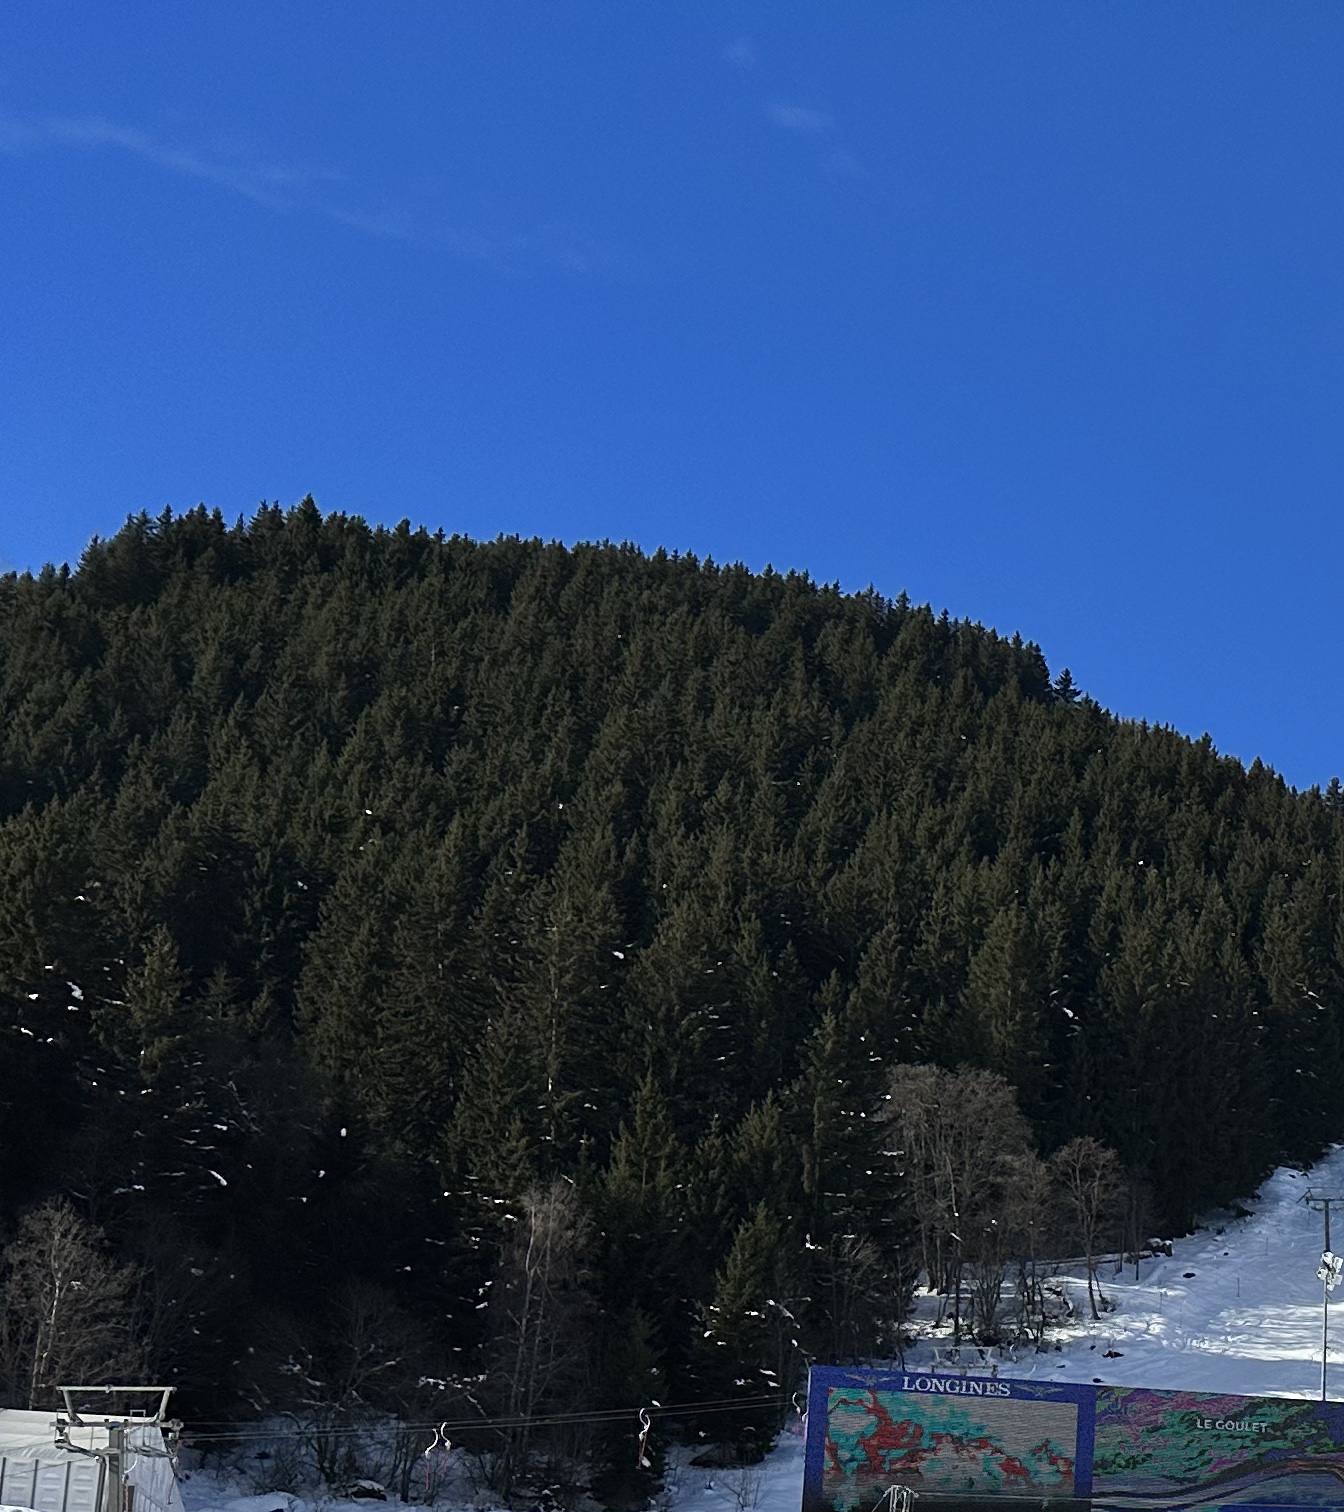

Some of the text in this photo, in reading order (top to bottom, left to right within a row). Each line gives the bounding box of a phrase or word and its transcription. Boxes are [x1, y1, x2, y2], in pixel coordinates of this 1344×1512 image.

[902, 1376, 1011, 1396] LONGINES
[1197, 1419, 1267, 1433] LE GOULET
